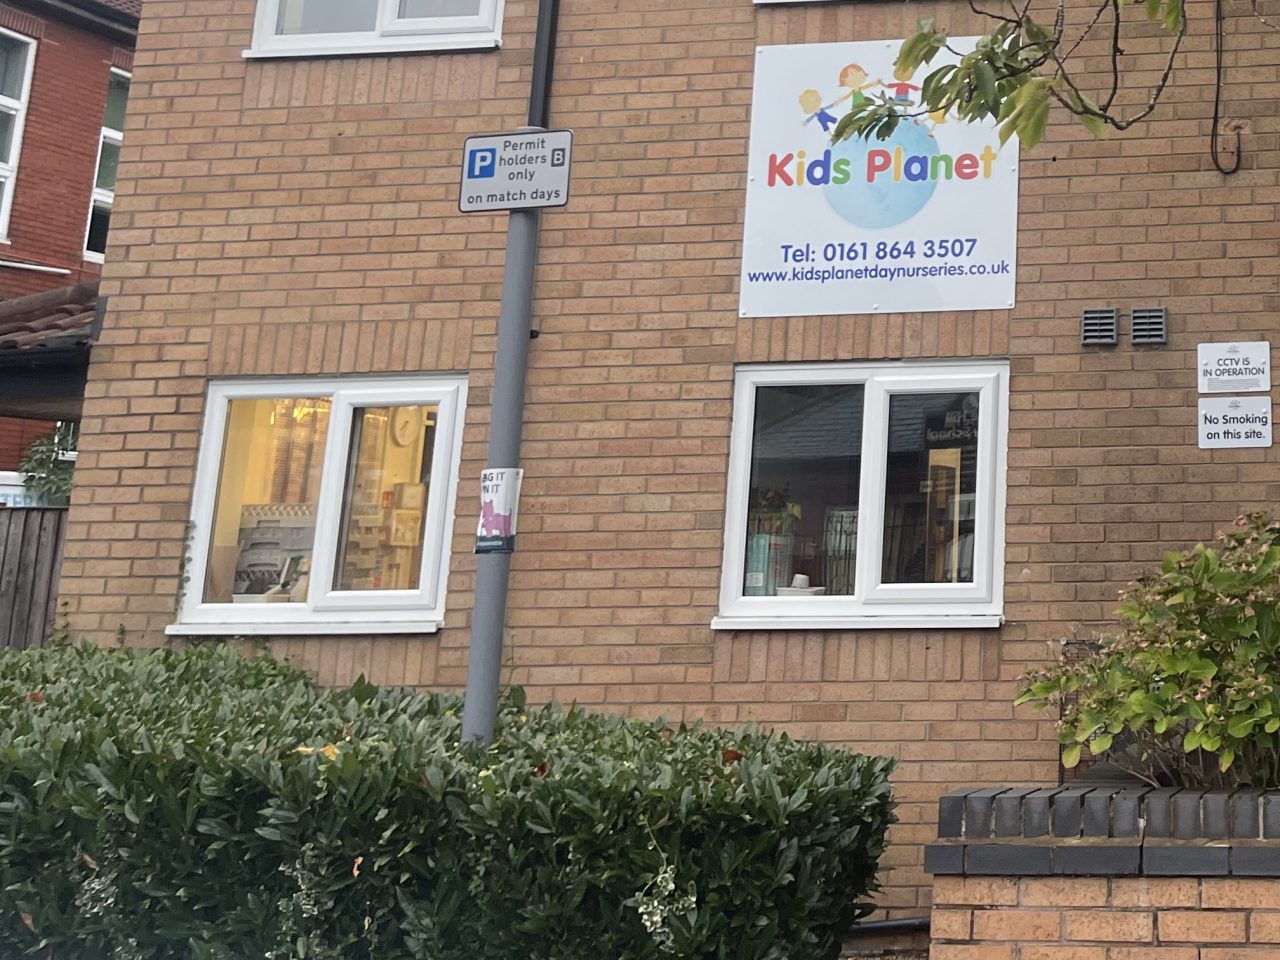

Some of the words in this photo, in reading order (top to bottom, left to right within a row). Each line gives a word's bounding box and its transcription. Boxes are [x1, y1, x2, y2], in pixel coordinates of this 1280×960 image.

[503, 138, 546, 152] Permit
[474, 151, 492, 176] P
[499, 154, 547, 166] holders
[553, 151, 563, 164] B
[767, 148, 851, 187] Kids
[866, 145, 997, 183] Planet
[508, 169, 536, 181] only
[467, 194, 483, 204] on
[487, 190, 526, 203] match
[531, 188, 561, 201] days
[781, 244, 816, 263] Tel:
[823, 242, 868, 262] 0161
[875, 240, 916, 259] 864
[923, 238, 978, 258] 3507
[748, 260, 1010, 284] www.kidsplanetdaynurseries.co.uk
[1217, 357, 1240, 367] CCTV
[1242, 357, 1251, 366] IS
[1203, 368, 1213, 377] IN
[1215, 367, 1265, 377] OPERATION
[1204, 415, 1219, 425] No
[1222, 414, 1268, 426] Smoking
[1207, 432, 1220, 440] on
[1223, 429, 1241, 439] this
[496, 472, 506, 482] IT
